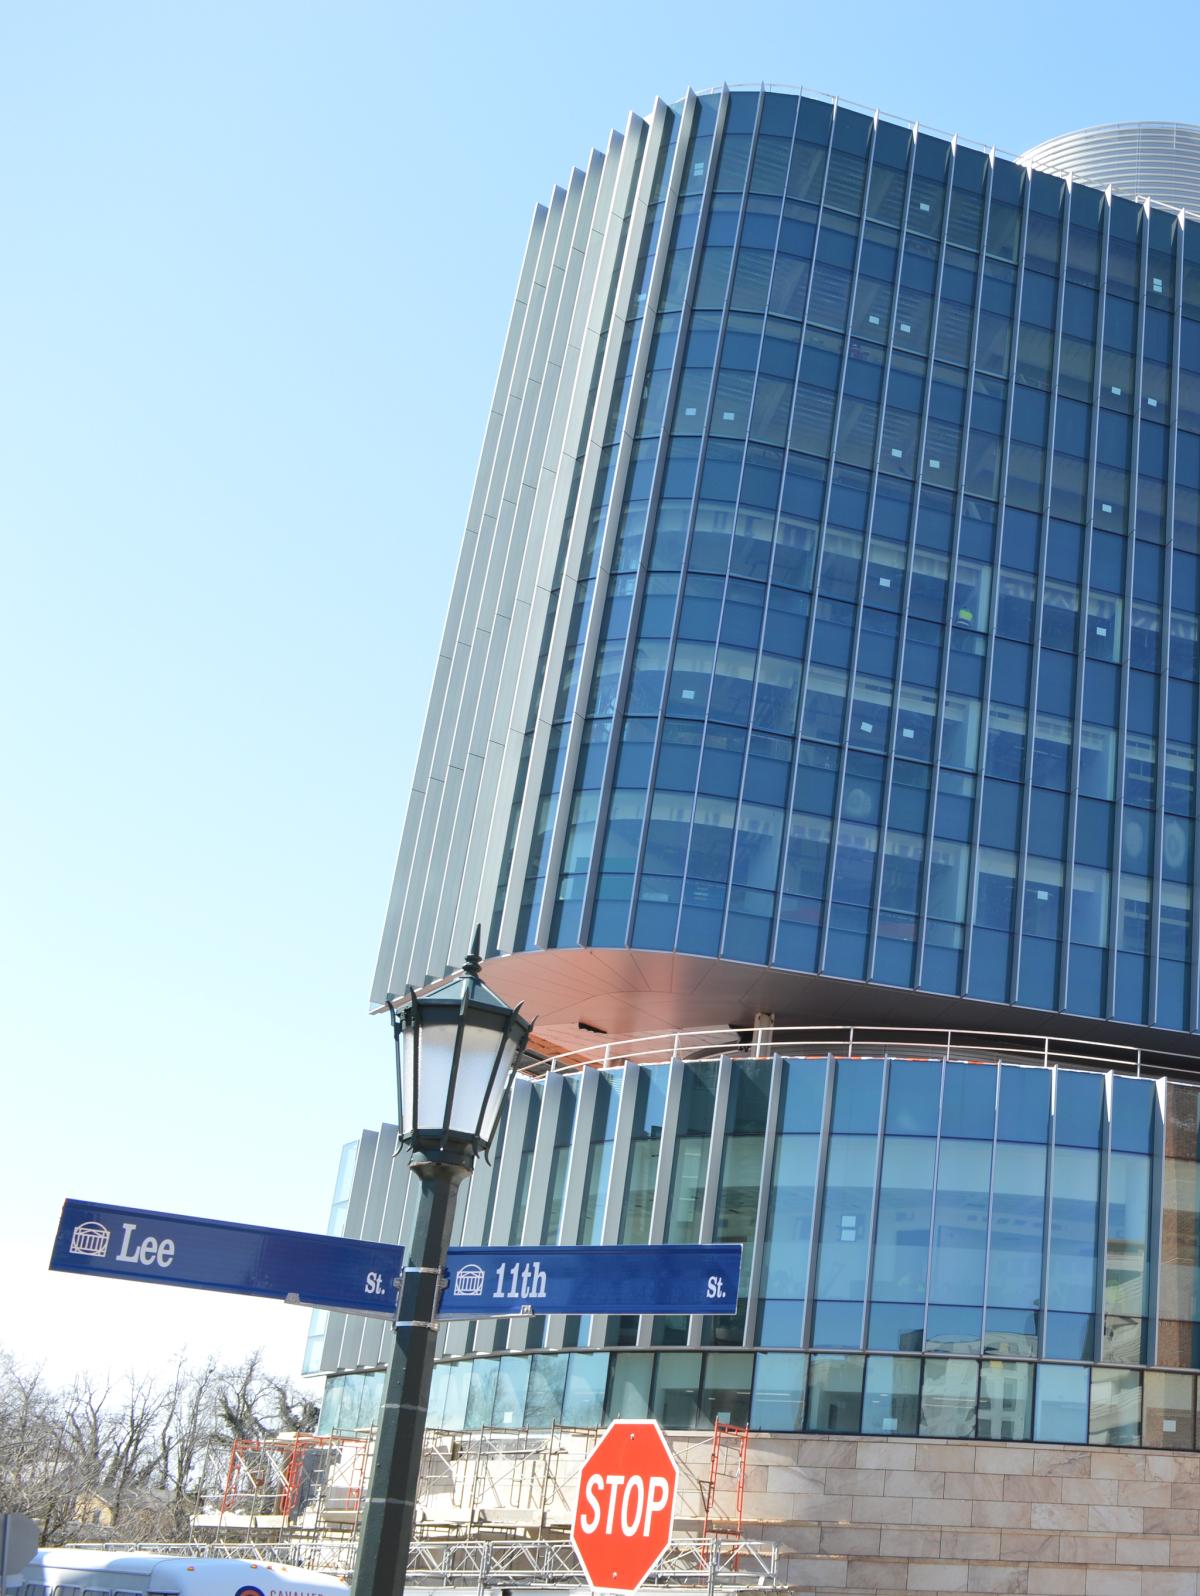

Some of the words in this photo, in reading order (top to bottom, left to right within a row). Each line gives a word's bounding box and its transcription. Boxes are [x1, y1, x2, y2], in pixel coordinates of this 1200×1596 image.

[115, 1223, 175, 1268] Lee
[364, 1272, 386, 1295] St.
[492, 1261, 548, 1299] 11th
[706, 1276, 727, 1299] St.
[580, 1473, 669, 1537] STOP
